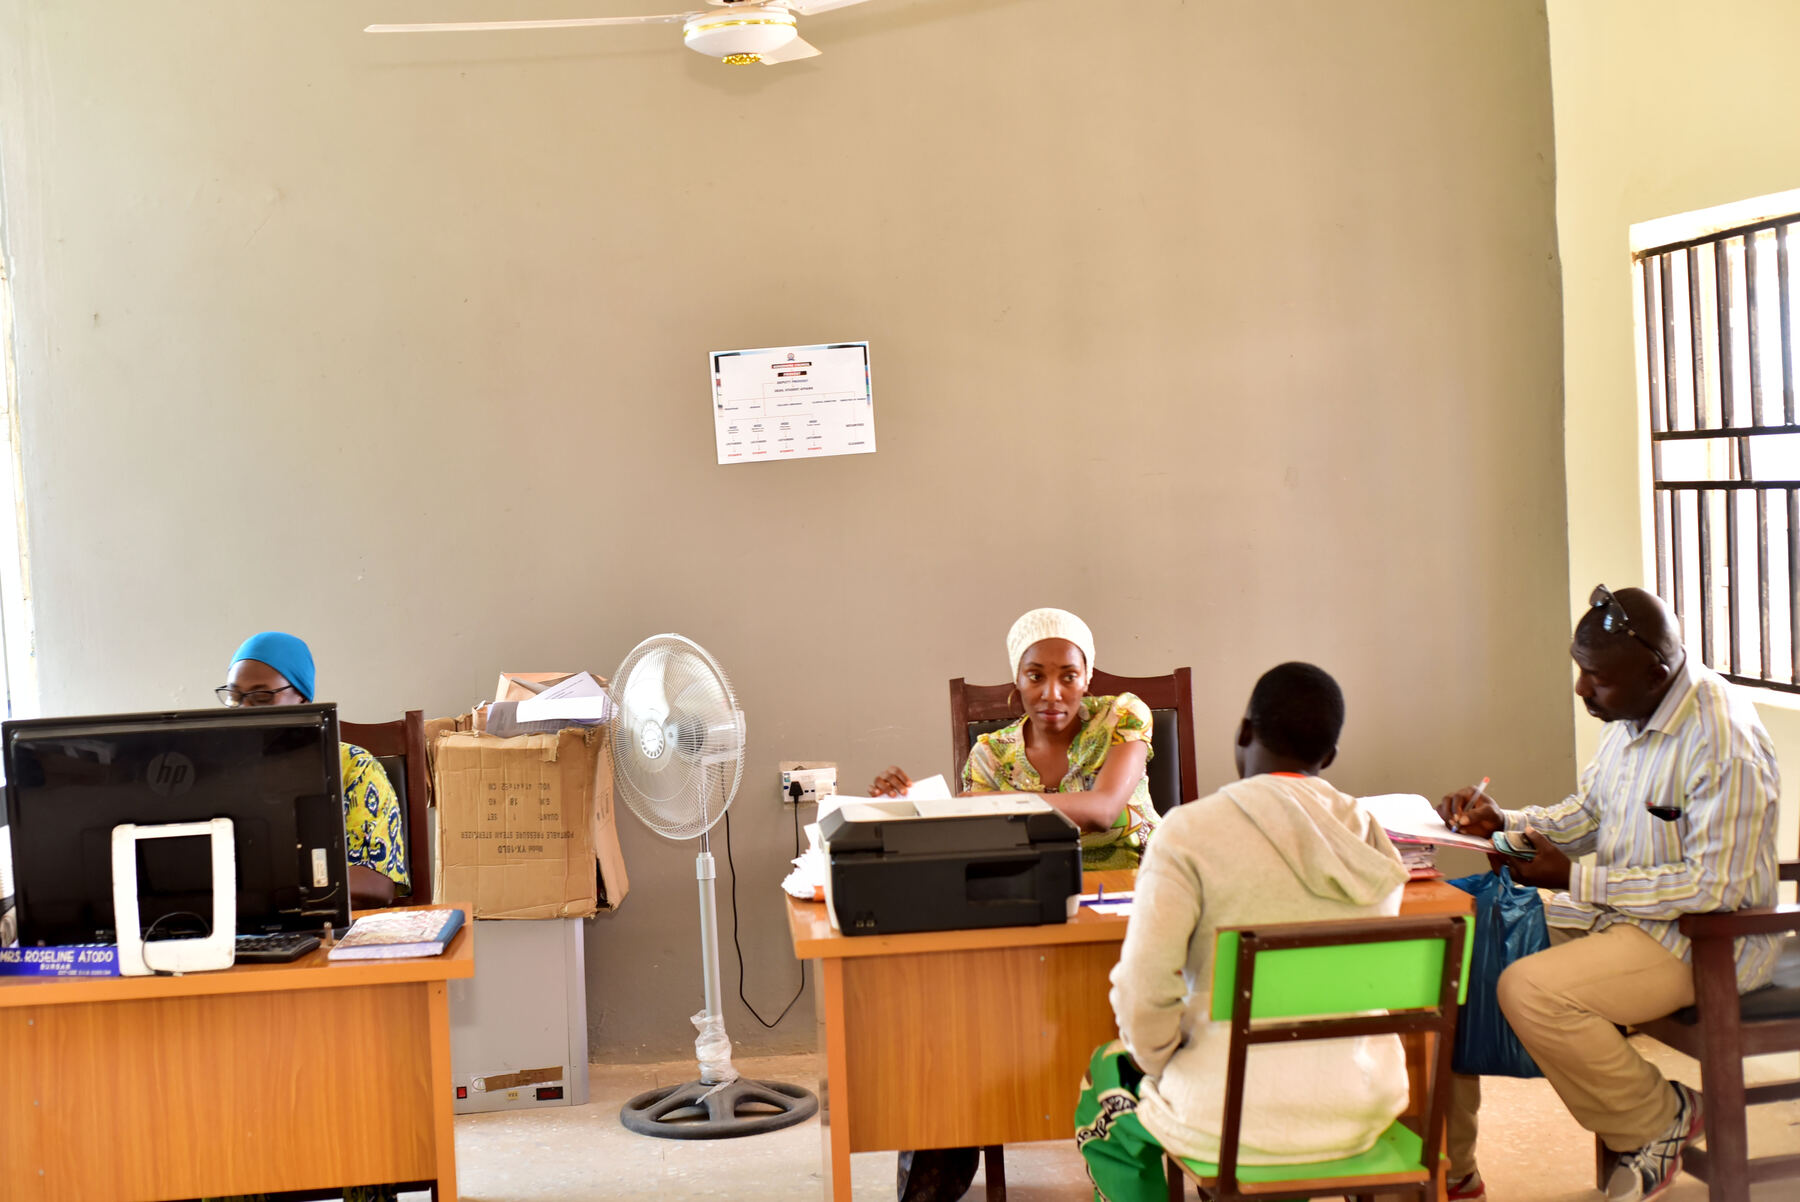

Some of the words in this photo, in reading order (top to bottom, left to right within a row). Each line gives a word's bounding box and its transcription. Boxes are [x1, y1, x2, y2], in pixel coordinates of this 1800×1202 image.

[155, 753, 188, 796] hp
[494, 831, 513, 840] STEAM
[515, 831, 545, 840] PRESSURE
[24, 949, 76, 963] ROSELINE
[78, 949, 114, 963] ATODO
